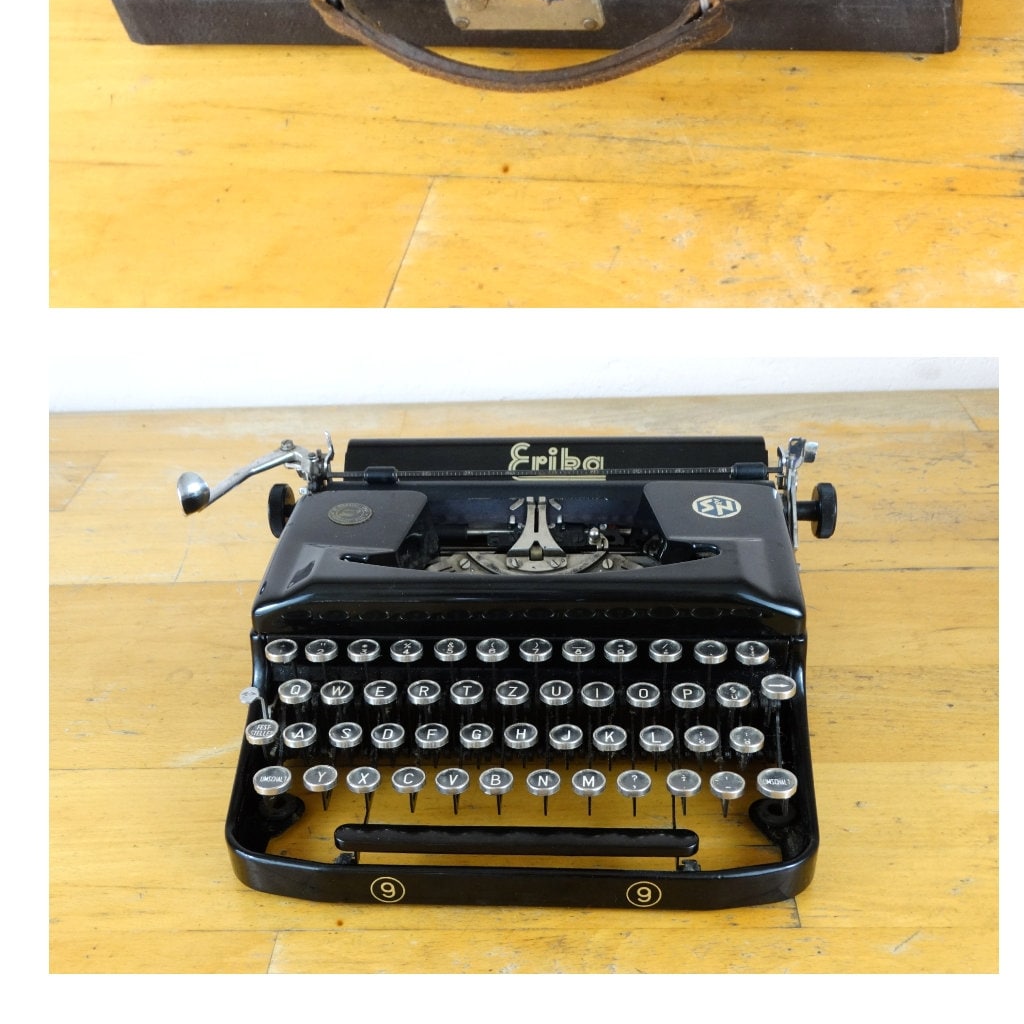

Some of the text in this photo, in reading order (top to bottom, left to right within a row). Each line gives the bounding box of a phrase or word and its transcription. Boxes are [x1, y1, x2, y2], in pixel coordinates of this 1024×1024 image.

[508, 442, 606, 480] Erika
[290, 684, 301, 695] Q
[331, 685, 346, 696] W
[375, 686, 386, 697] E
[418, 686, 430, 696] R
[462, 685, 472, 696] T
[507, 686, 518, 697] Z
[551, 686, 562, 696] U
[638, 688, 649, 698] O
[682, 688, 693, 699] P
[294, 728, 662, 744] A S D F G H J K L
[317, 771, 326, 782] Y
[357, 773, 369, 784] X
[403, 773, 415, 784] C
[449, 774, 459, 785] V
[490, 774, 501, 785] B
[537, 775, 549, 786] N
[582, 776, 595, 787] M
[380, 881, 396, 898] 9
[636, 886, 652, 902] 9
